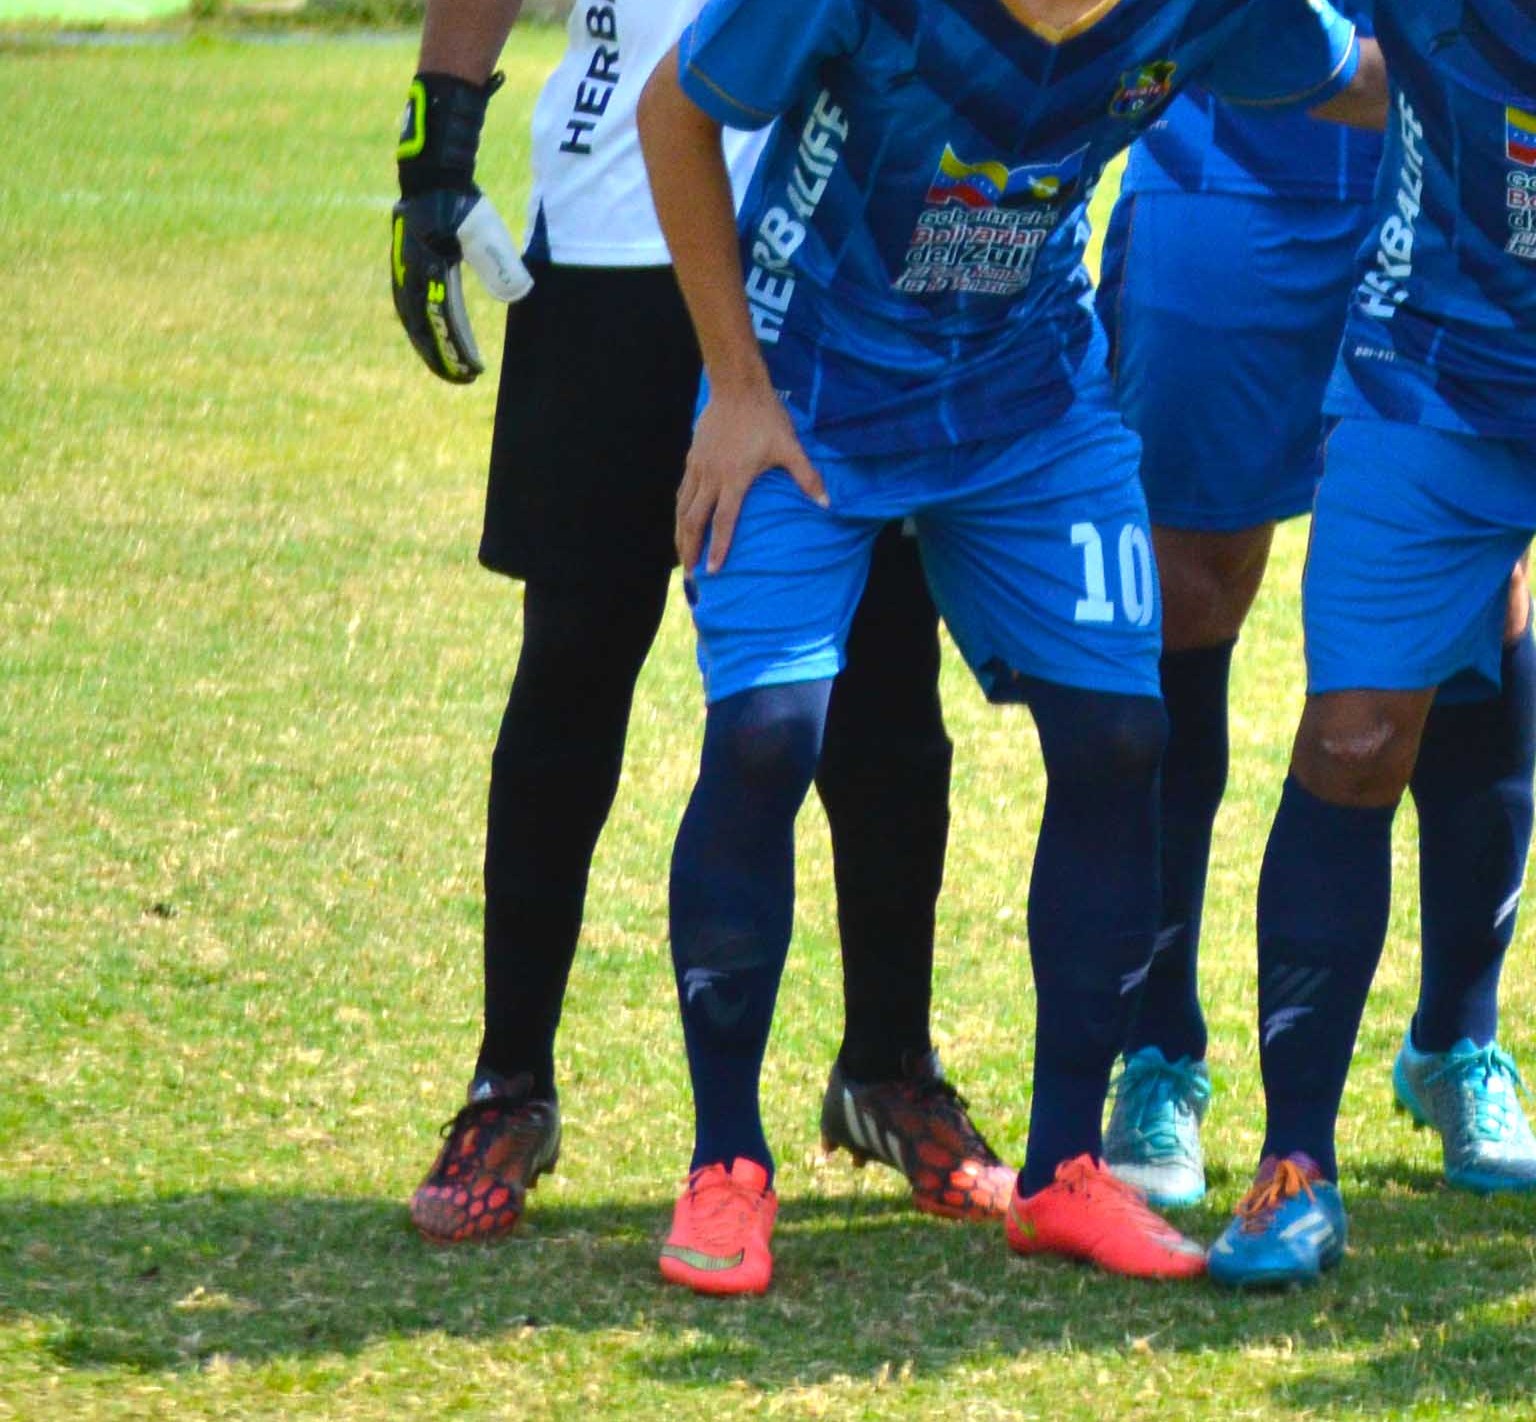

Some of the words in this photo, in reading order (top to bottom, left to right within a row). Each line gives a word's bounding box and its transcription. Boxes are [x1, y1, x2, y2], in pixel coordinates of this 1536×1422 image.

[905, 243, 958, 266] del
[959, 242, 1037, 268] Zuli
[1070, 522, 1154, 627] 10
